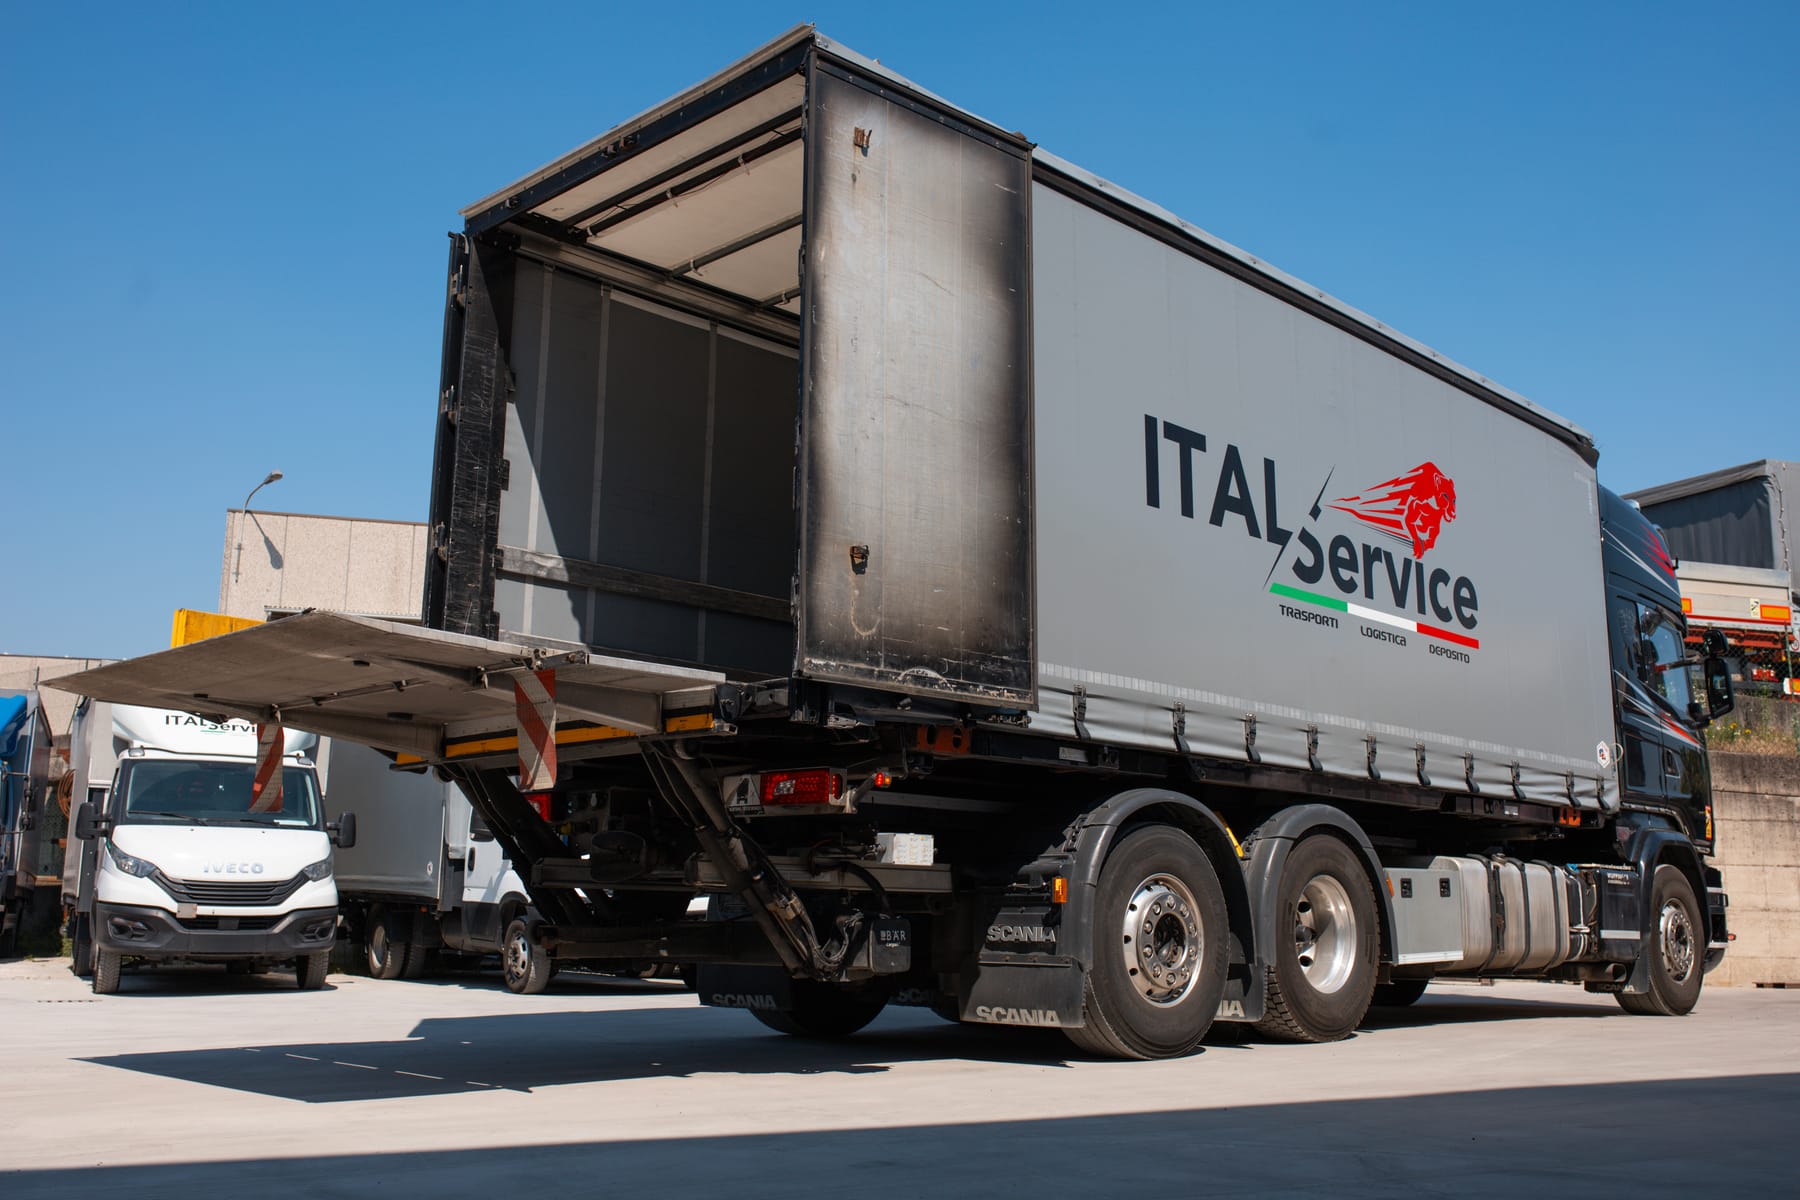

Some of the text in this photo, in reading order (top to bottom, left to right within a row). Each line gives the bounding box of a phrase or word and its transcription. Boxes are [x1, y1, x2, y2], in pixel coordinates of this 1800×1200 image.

[1429, 644, 1470, 663] DEPOSITO
[203, 863, 264, 874] IVECO
[986, 925, 1056, 942] SCANIA
[712, 993, 777, 1008] SCANIA
[976, 1005, 1061, 1025] SCANIA
